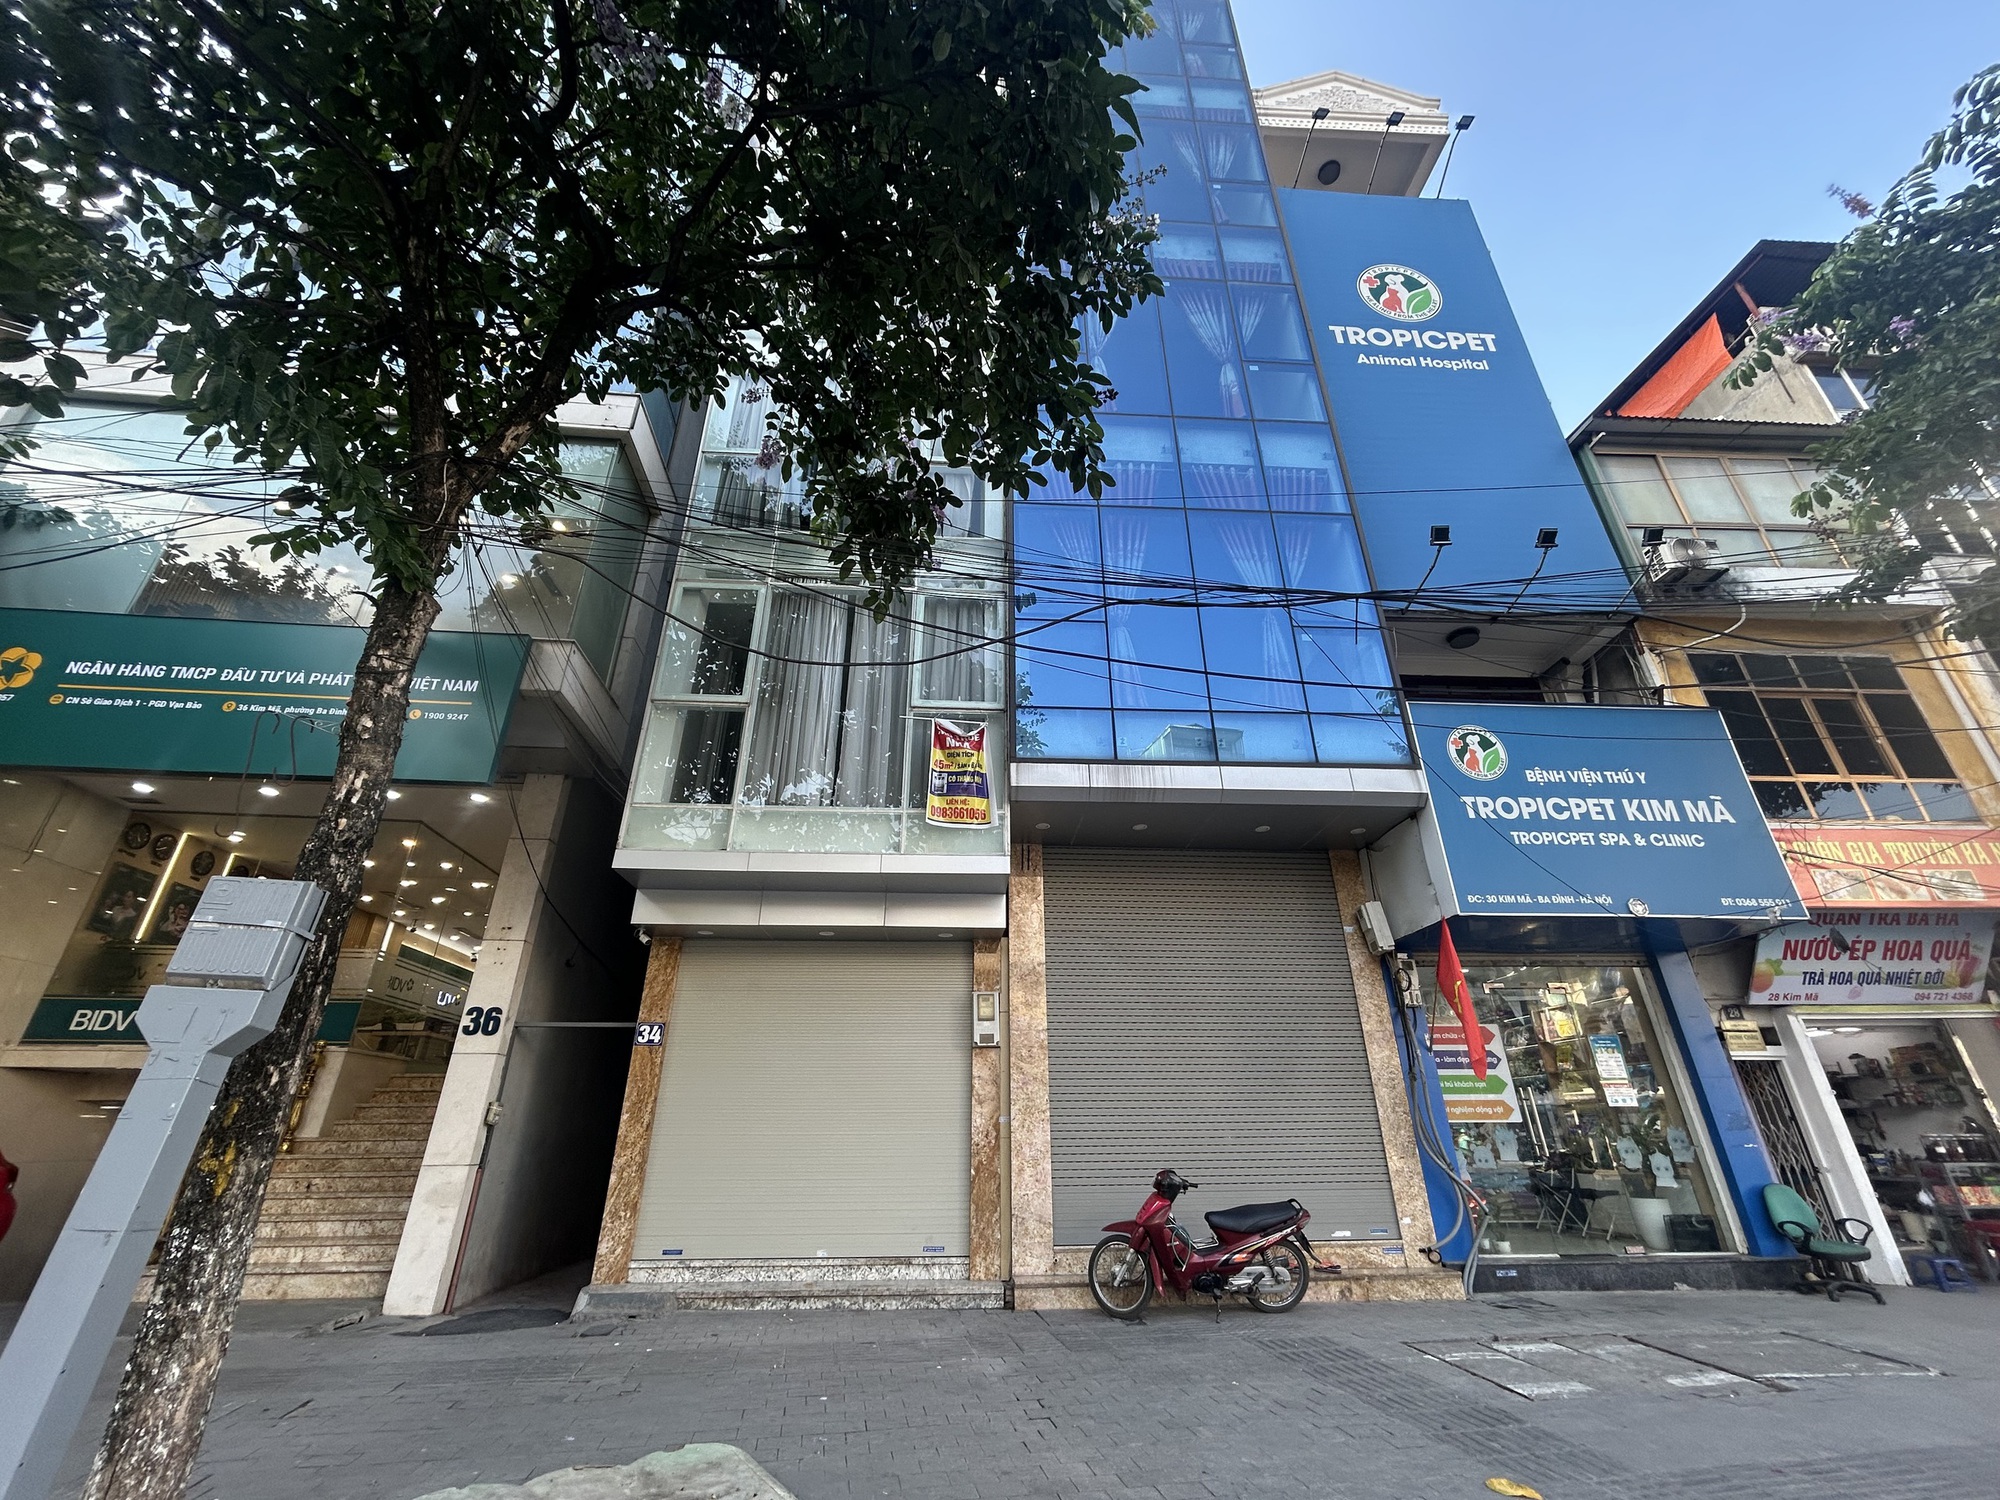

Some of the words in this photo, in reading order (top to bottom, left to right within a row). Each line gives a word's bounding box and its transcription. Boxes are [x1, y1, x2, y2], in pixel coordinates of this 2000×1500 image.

[1328, 325, 1497, 352] TROPICPET
[1357, 353, 1417, 368] Animal
[1419, 356, 1489, 372] Hospital
[65, 660, 116, 676] NGÂN
[117, 662, 167, 678] HÀNG
[170, 666, 217, 680] TMCP
[260, 670, 286, 683] TƯ
[285, 669, 305, 685] VÀ
[308, 671, 354, 687] PHÁT
[442, 679, 479, 692] NAM
[65, 696, 80, 704] CN
[93, 698, 113, 706] Giao
[113, 698, 133, 707] Dịch
[135, 699, 141, 707] 1
[148, 700, 167, 708] PGD
[169, 700, 185, 709] Vạn
[237, 704, 248, 712] 36
[249, 704, 266, 712] Kim
[284, 706, 315, 716] phường
[316, 707, 328, 715] Ba
[424, 712, 445, 720] 1900
[946, 751, 960, 759] DIỆN
[961, 750, 974, 758] TÍCH
[1525, 766, 1566, 786] BỆNH
[1567, 767, 1601, 786] VIỆN
[1604, 768, 1635, 784] THÚ
[1635, 772, 1646, 784] Y
[945, 797, 959, 805] LIÊN
[1460, 795, 1616, 821] TROPICPET
[1621, 798, 1681, 822] KIM
[1682, 795, 1737, 824] MÃ
[930, 805, 986, 820] 0983661056
[1510, 831, 1596, 846] TROPICPET
[1599, 833, 1632, 847] SPA
[1634, 833, 1648, 847] &
[1650, 833, 1706, 848] CLINIC
[1847, 842, 1885, 864] GIA
[1881, 837, 1959, 865] TRUYỀN
[1960, 840, 1992, 865] HÀ
[1467, 894, 1485, 903] ĐC:
[1486, 895, 1497, 903] 30
[1499, 895, 1516, 903] KIM
[1516, 893, 1533, 904] MÃ
[1537, 895, 1550, 904] BA
[1551, 893, 1574, 904] ĐÌNH
[1581, 894, 1595, 904] HÀ
[1595, 894, 1613, 907] NỘI
[1735, 898, 1758, 906] 0368
[1757, 898, 1775, 907] 555
[1848, 934, 1877, 961] ÉP
[1882, 939, 1923, 961] HOA
[1929, 932, 1971, 963] QUẢ
[1802, 968, 1825, 986] TRÀ
[1828, 971, 1853, 986] HOA
[1767, 992, 1780, 1001] 28
[1782, 992, 1802, 1001] Kim
[1804, 991, 1819, 1001] Mã
[68, 1009, 138, 1031] BIDV
[462, 1006, 503, 1036] 36
[1727, 1007, 1740, 1018] 28
[637, 1025, 661, 1043] 34
